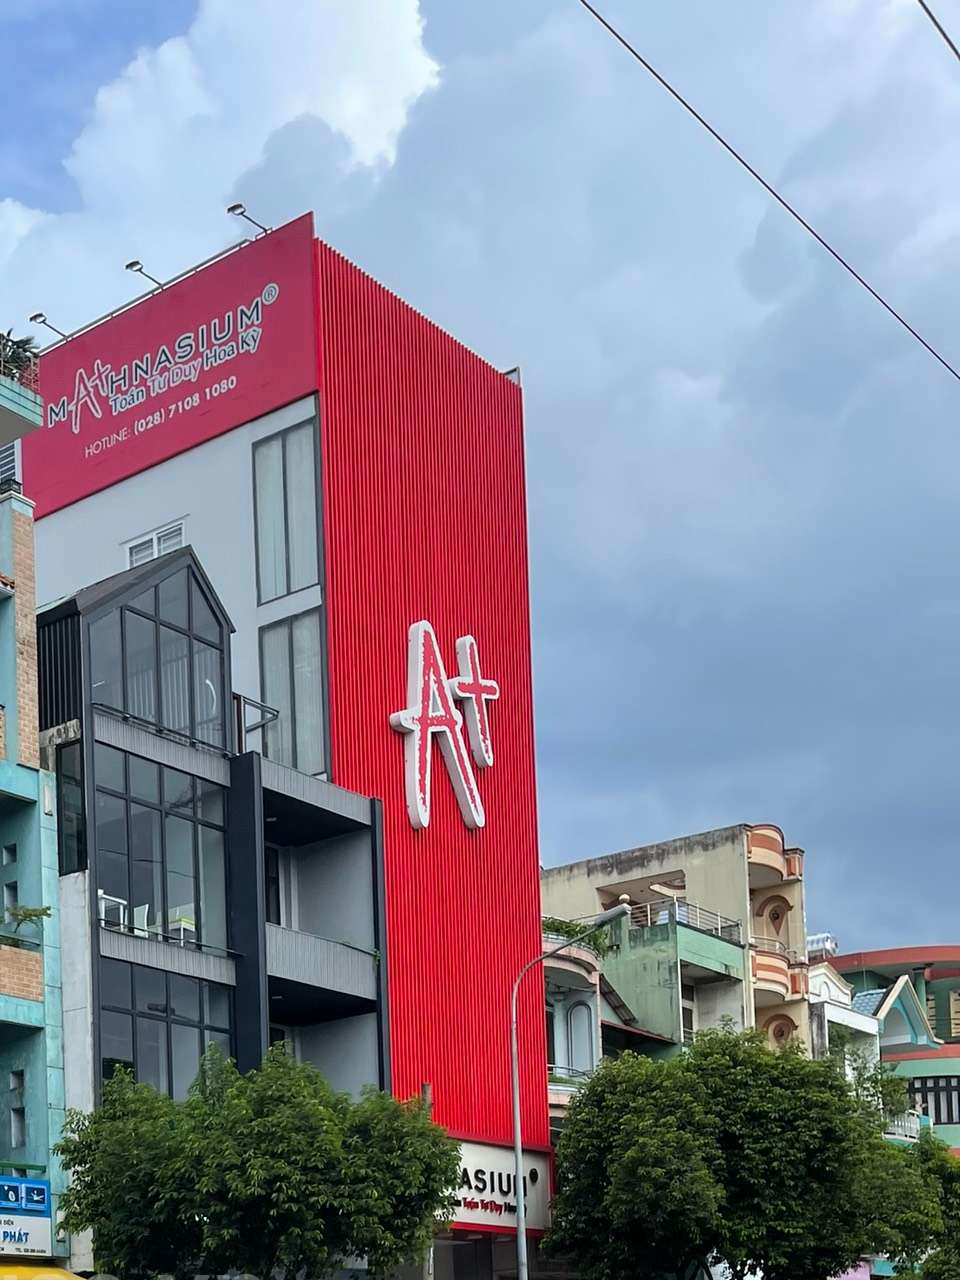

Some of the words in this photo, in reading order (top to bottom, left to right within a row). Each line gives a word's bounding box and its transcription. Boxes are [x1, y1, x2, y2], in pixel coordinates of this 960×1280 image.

[109, 387, 146, 416] Toán
[147, 376, 170, 397] Tư
[170, 357, 202, 383] Duy
[203, 342, 236, 370] Hoa
[239, 326, 263, 354] Kỳ
[84, 428, 132, 458] HOTLINE:
[134, 408, 165, 435] (028)
[168, 394, 200, 419] 7108
[205, 376, 237, 400] 1080
[2, 1227, 29, 1243] PHÁT
